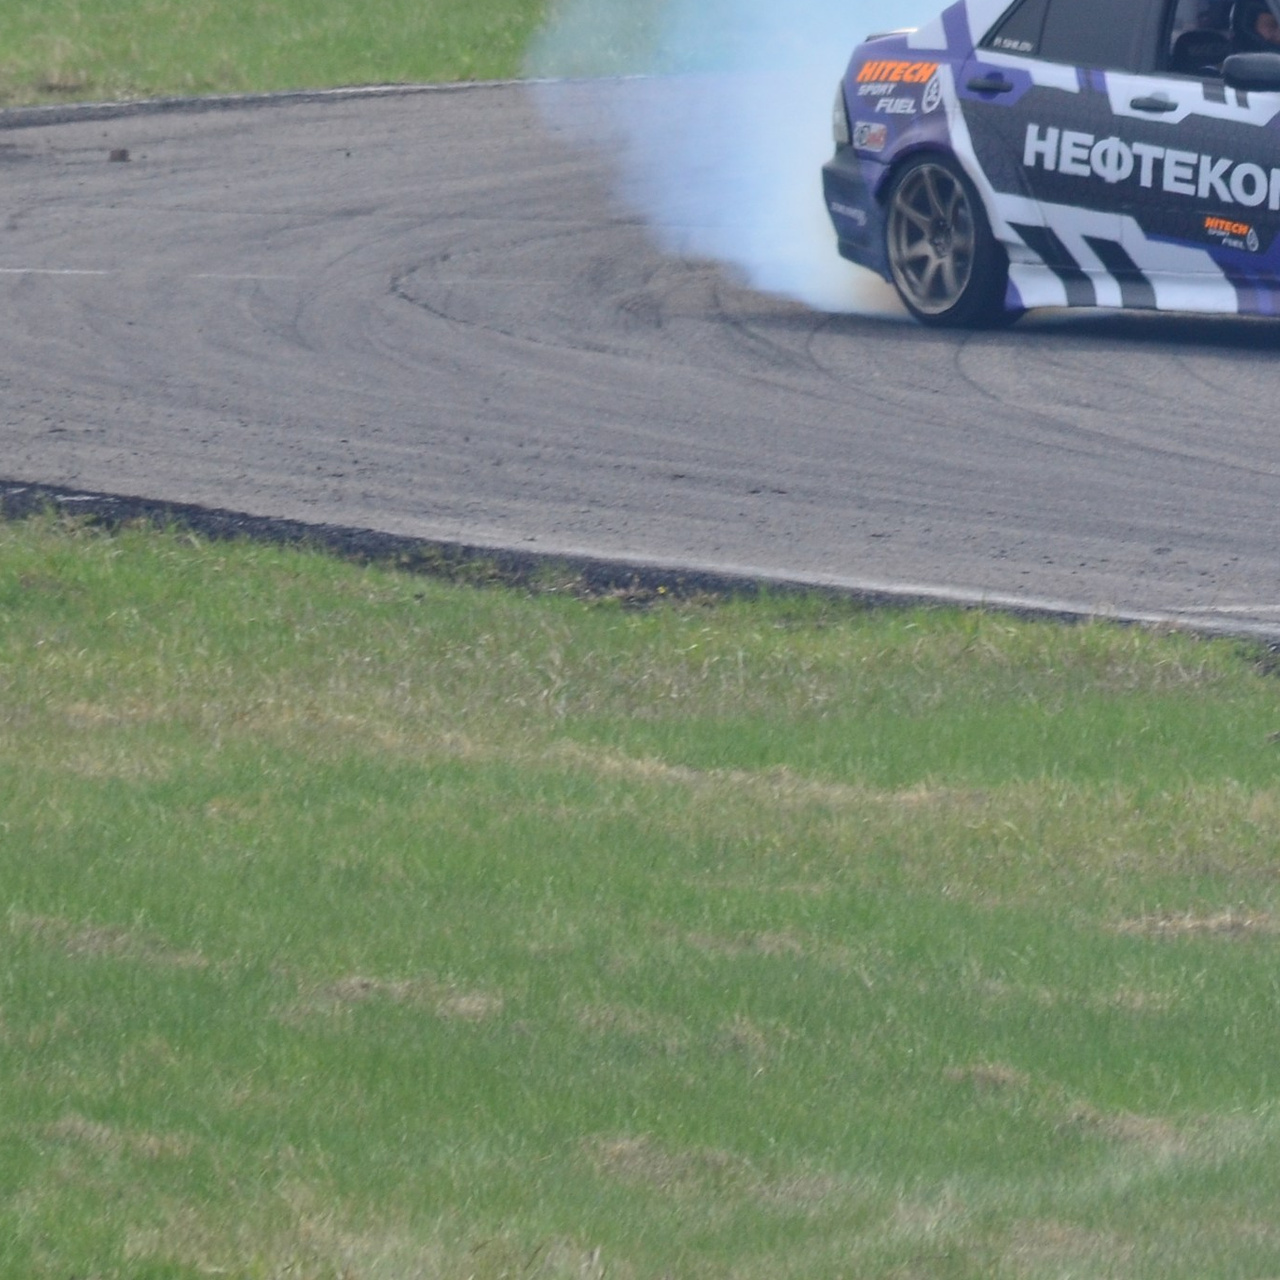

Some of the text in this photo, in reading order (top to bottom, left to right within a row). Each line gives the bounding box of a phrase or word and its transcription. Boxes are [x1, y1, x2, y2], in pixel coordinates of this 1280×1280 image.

[856, 60, 940, 83] HITECH
[857, 82, 898, 97] SPORT
[875, 98, 917, 114] FUEL
[1204, 216, 1250, 236] HITECH
